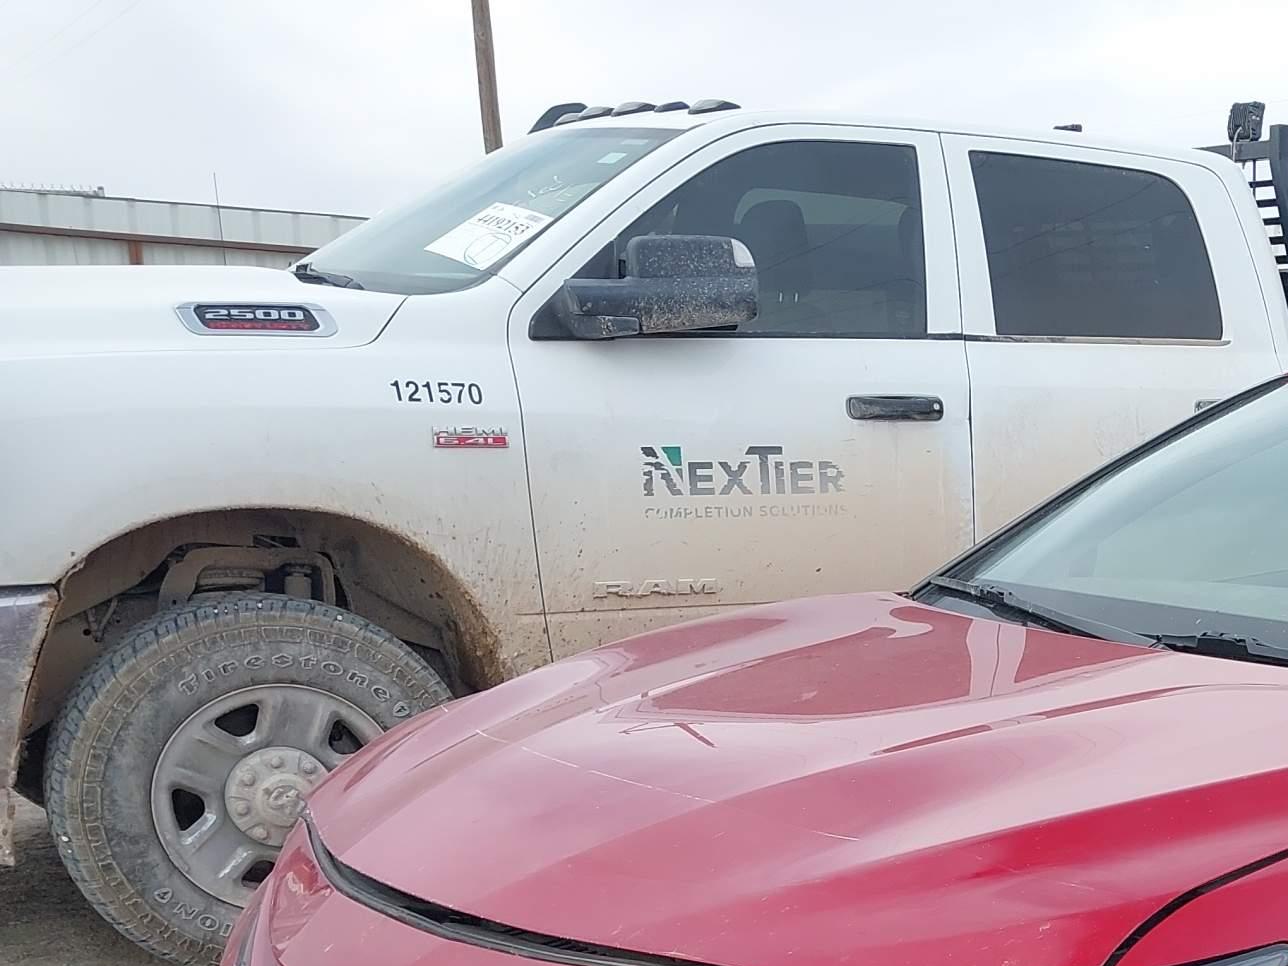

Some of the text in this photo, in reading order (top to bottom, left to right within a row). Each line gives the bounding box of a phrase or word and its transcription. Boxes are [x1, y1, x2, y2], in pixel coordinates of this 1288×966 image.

[204, 308, 304, 321] 2500
[390, 379, 483, 405] 121570
[432, 425, 508, 436] HEMI
[437, 436, 507, 446] 6.4L
[593, 577, 718, 599] RAM
[178, 653, 393, 697] Firestone
